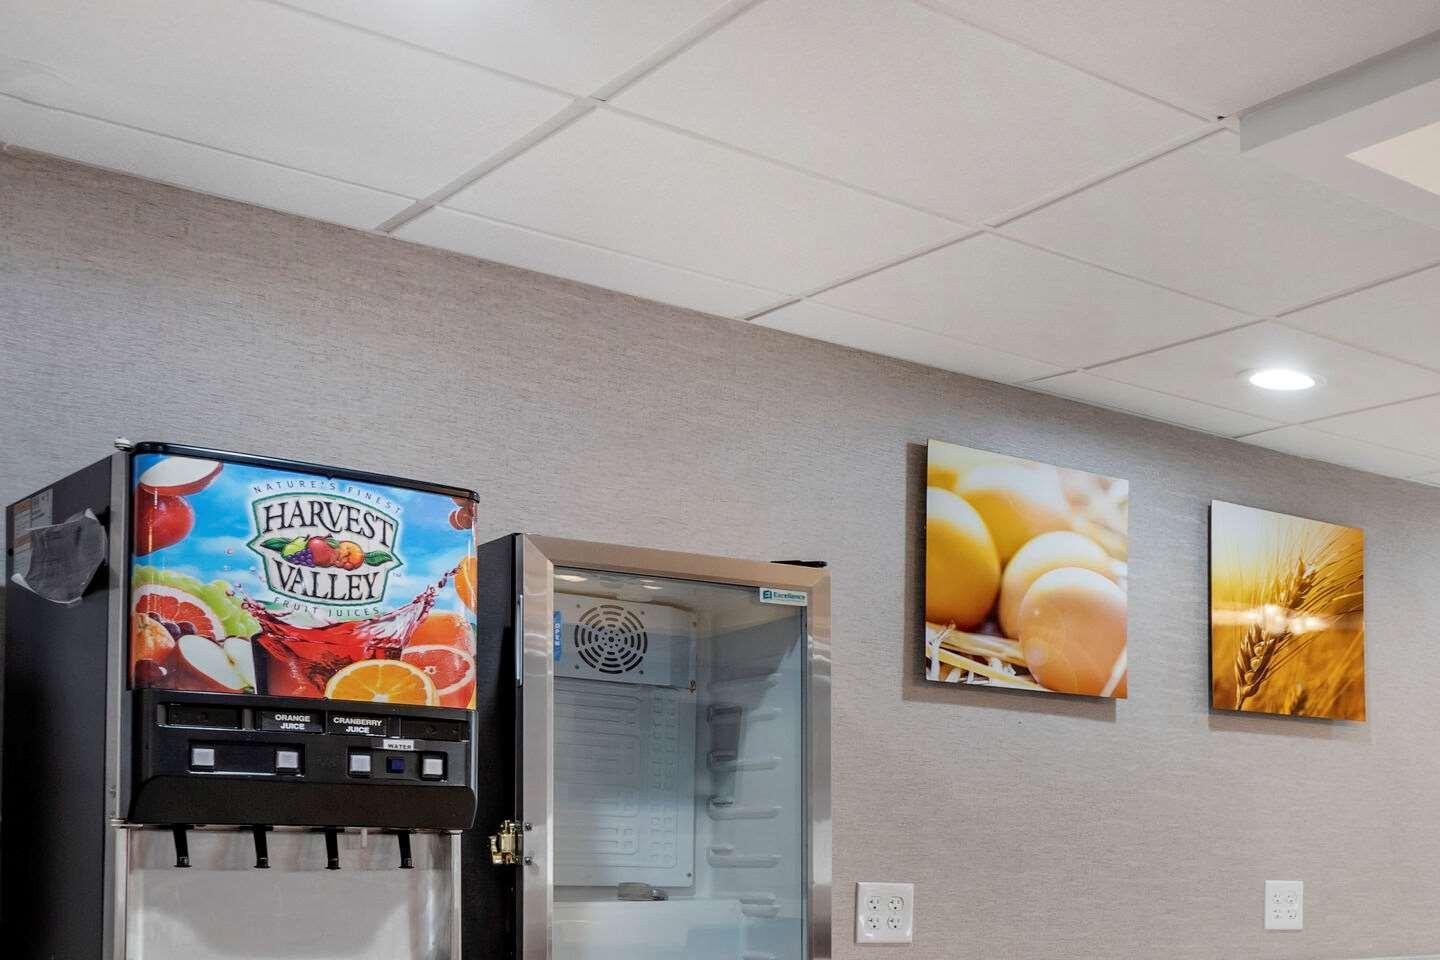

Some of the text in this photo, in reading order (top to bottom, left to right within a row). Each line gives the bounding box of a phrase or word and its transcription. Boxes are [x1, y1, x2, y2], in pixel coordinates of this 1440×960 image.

[253, 480, 401, 514] NATURE'S FINEST
[263, 499, 394, 548] HARVEST
[272, 557, 380, 601] VALLEY
[273, 597, 380, 617] FRUIT JUICES
[275, 713, 311, 723] ORANGE
[333, 716, 382, 727] CRANBERRY
[280, 722, 305, 731] JUICE
[346, 725, 370, 734] JUICE
